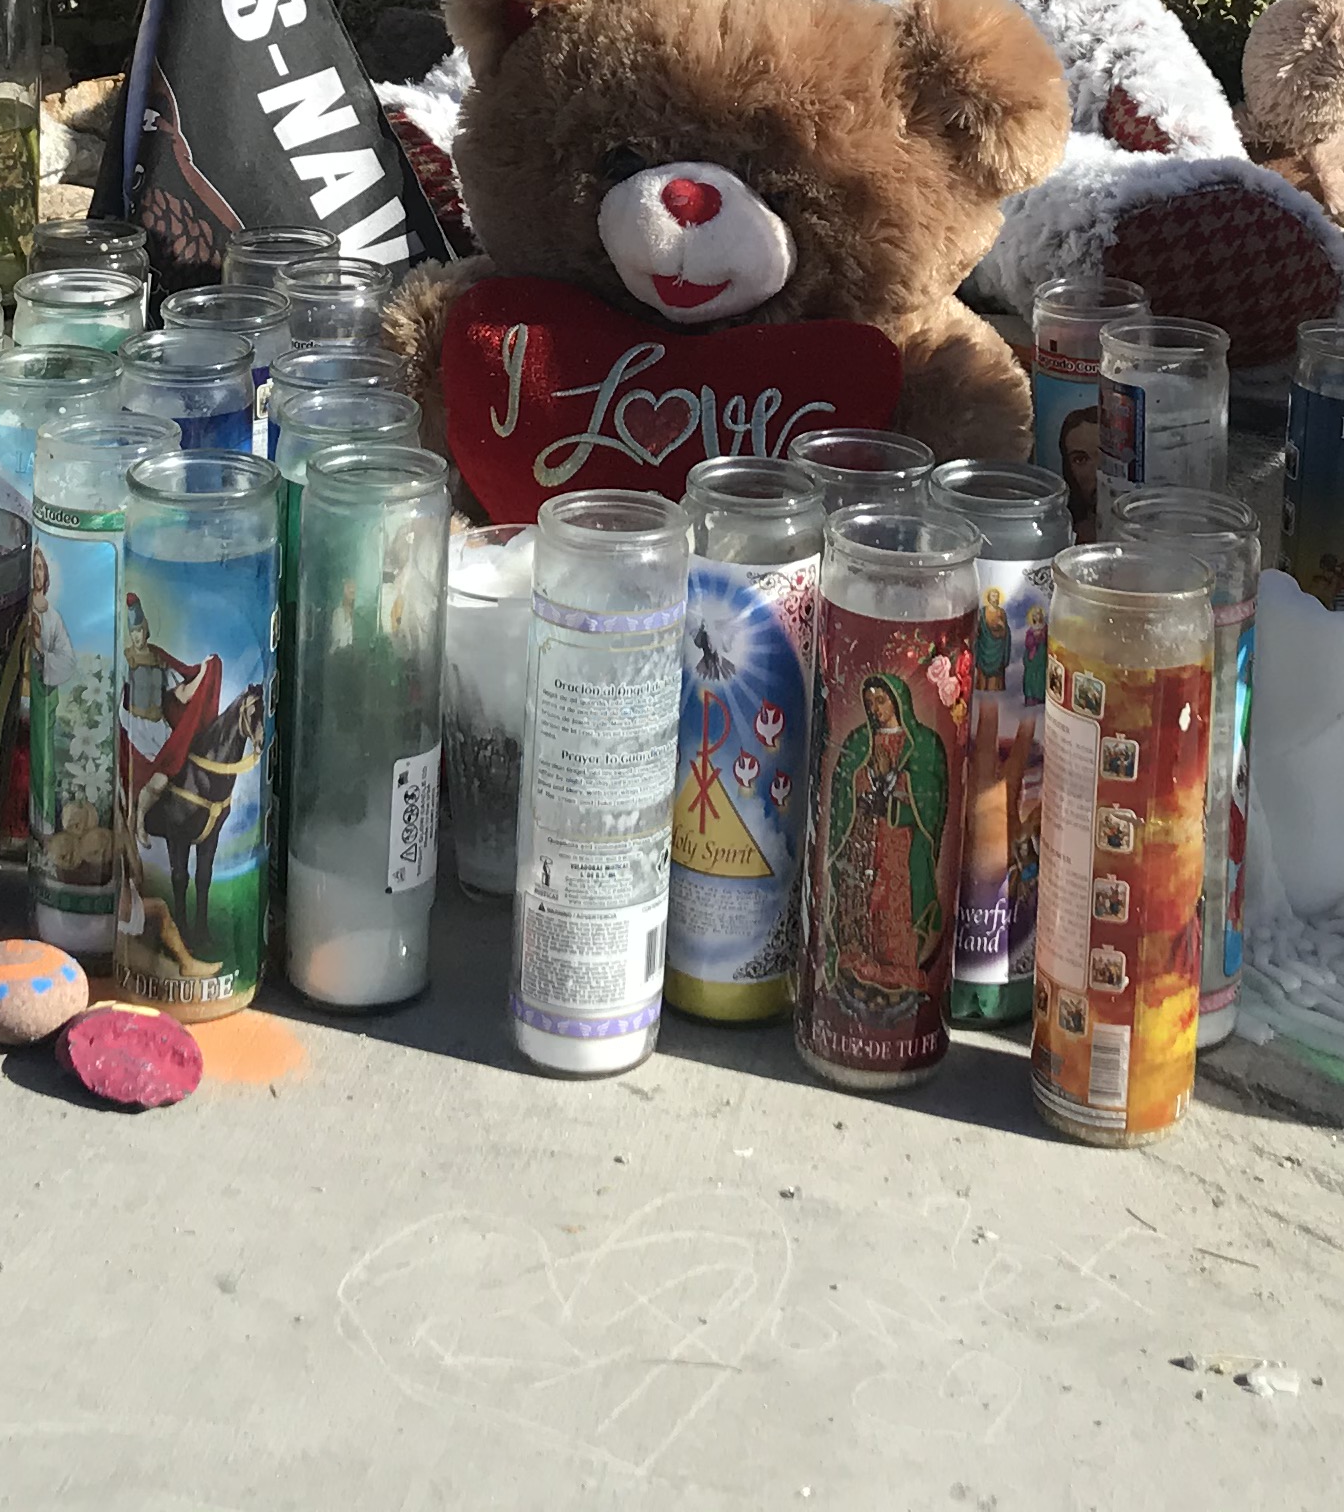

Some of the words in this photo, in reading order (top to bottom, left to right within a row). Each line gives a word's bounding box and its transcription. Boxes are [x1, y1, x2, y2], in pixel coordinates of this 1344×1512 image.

[561, 749, 601, 765] Prayer
[605, 752, 617, 765] to
[701, 839, 756, 869] Spirit
[959, 897, 1018, 936] werful
[136, 973, 160, 999] DE
[164, 978, 196, 1003] TU
[868, 1039, 893, 1060] DE
[897, 1037, 919, 1058] TU
